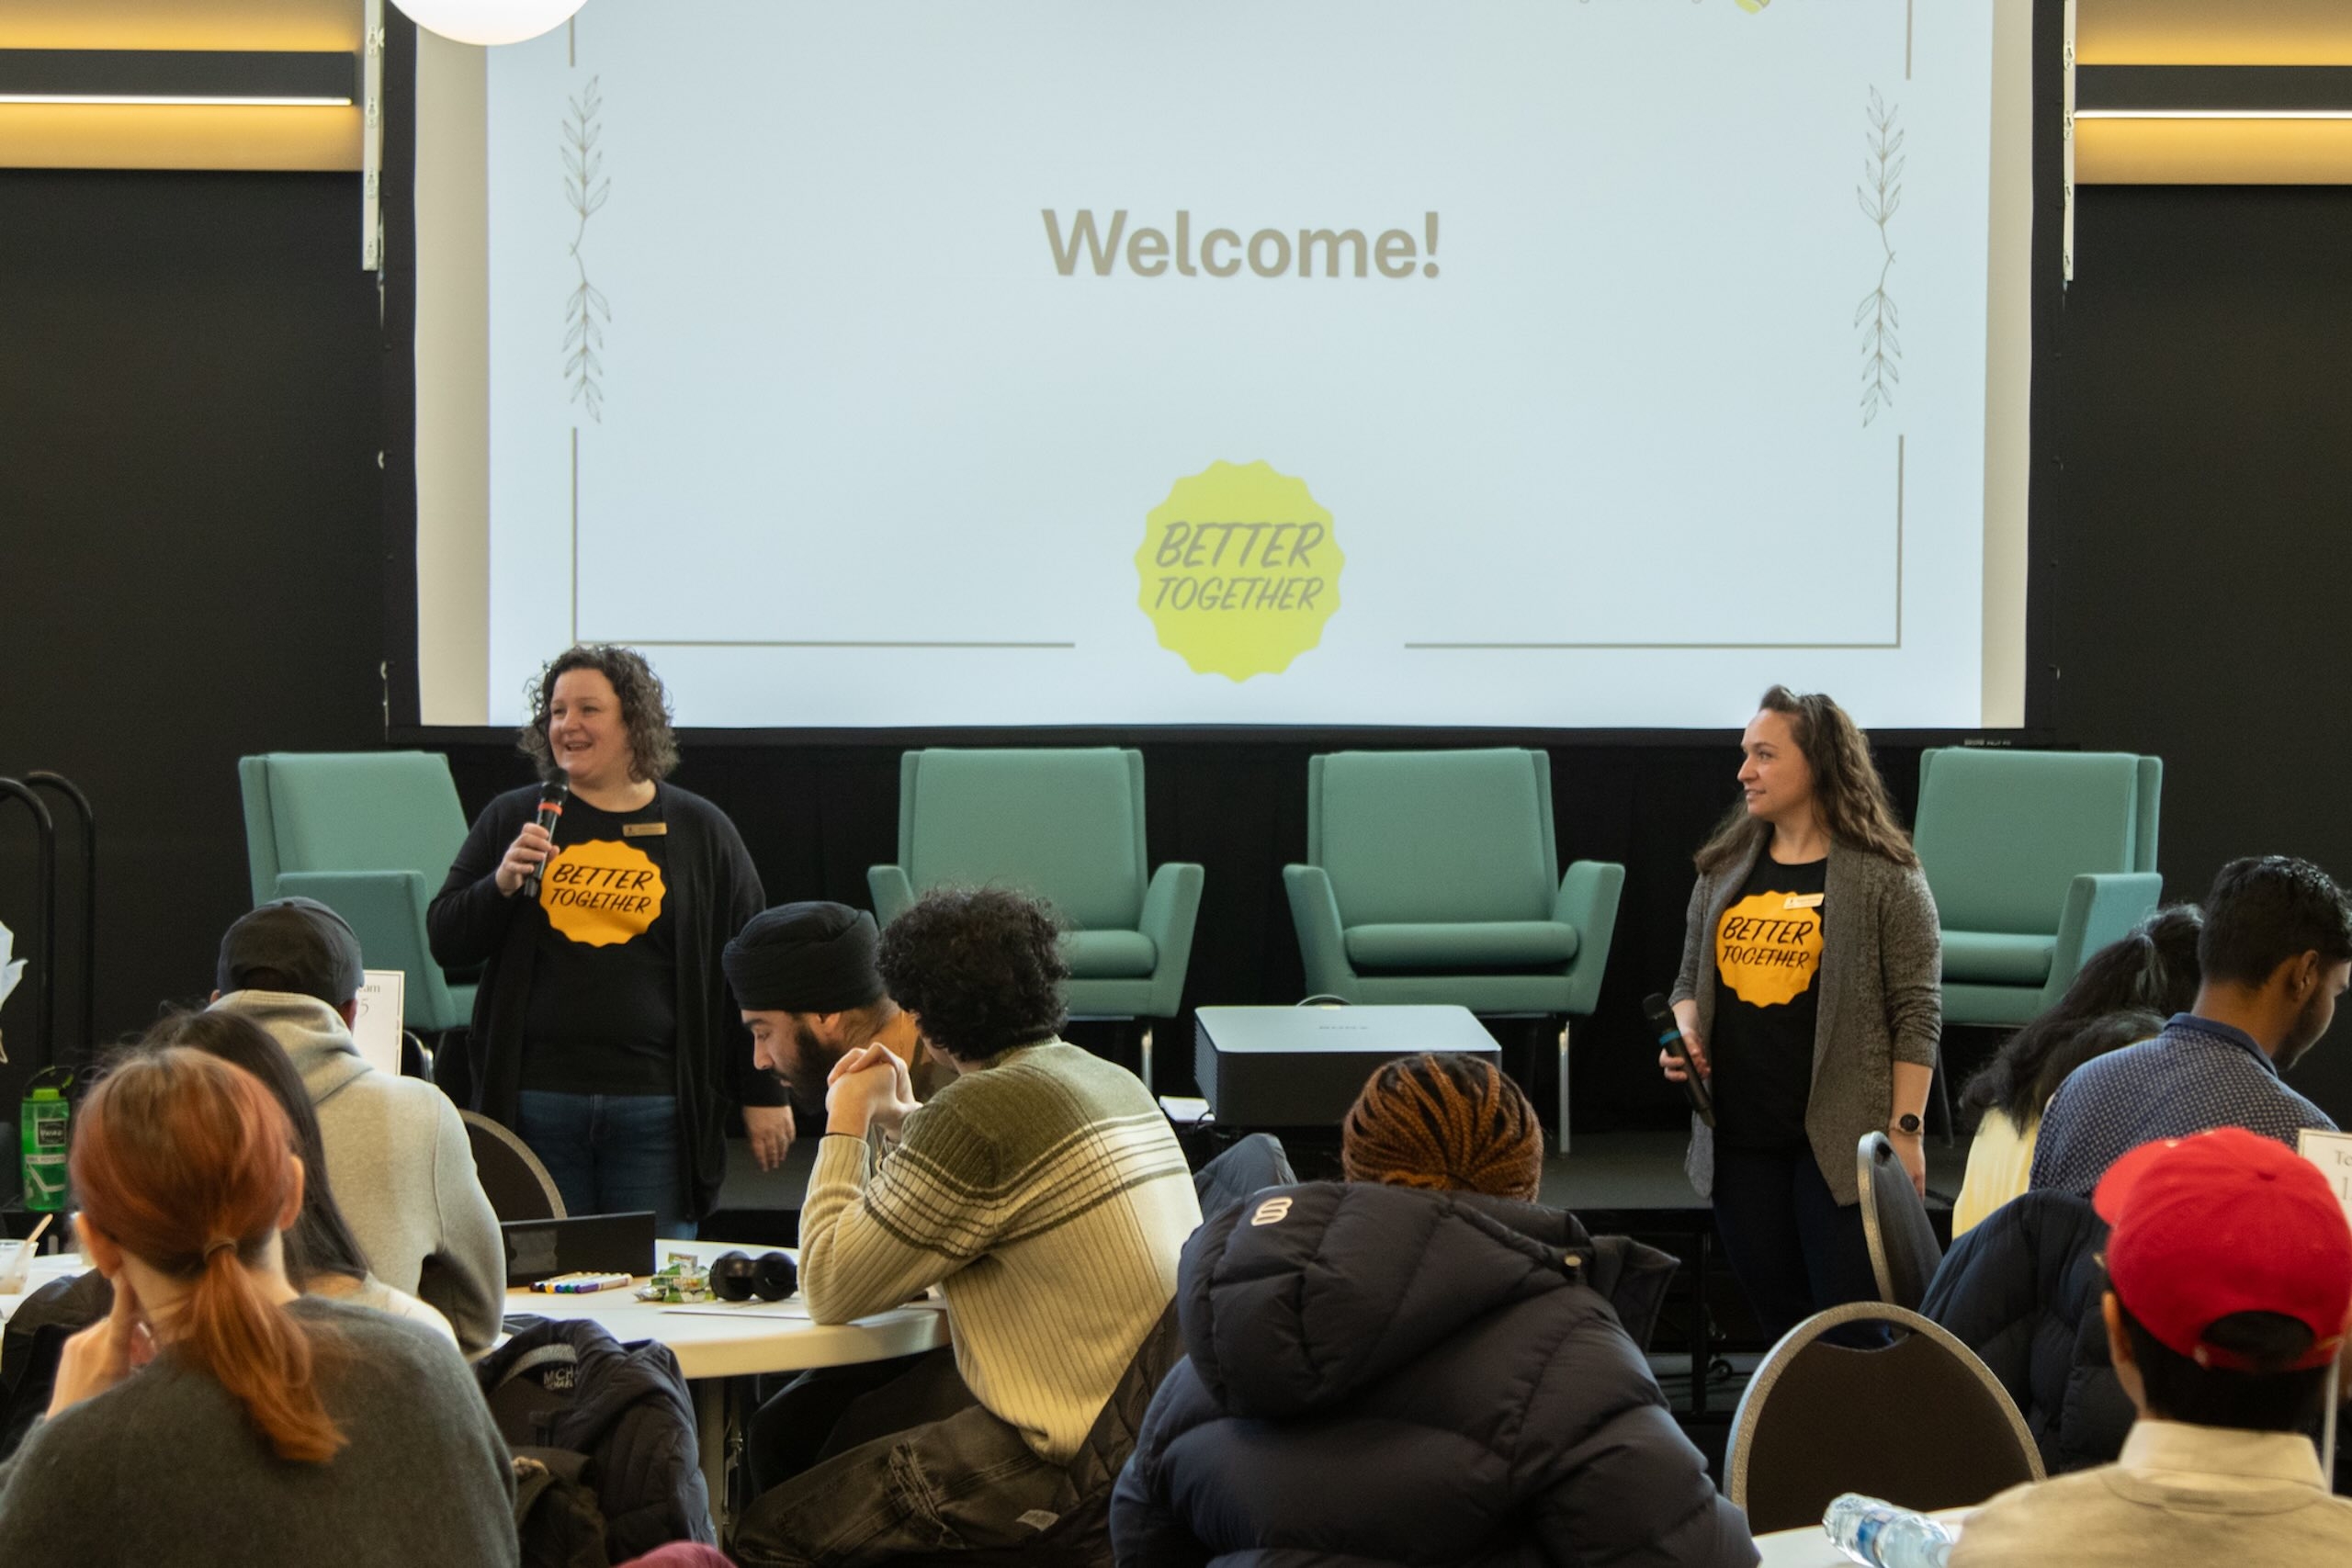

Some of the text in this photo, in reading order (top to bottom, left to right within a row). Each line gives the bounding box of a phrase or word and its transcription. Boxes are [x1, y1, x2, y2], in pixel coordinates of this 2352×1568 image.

[1041, 209, 1441, 278] Welcome!
[1155, 521, 1326, 569] BETTER
[1154, 576, 1325, 611] TOGETHER
[552, 863, 654, 892] BETTER
[549, 887, 652, 915] TOGETHER
[1722, 916, 1815, 946] BETTER
[1721, 944, 1811, 970] TOGETHER
